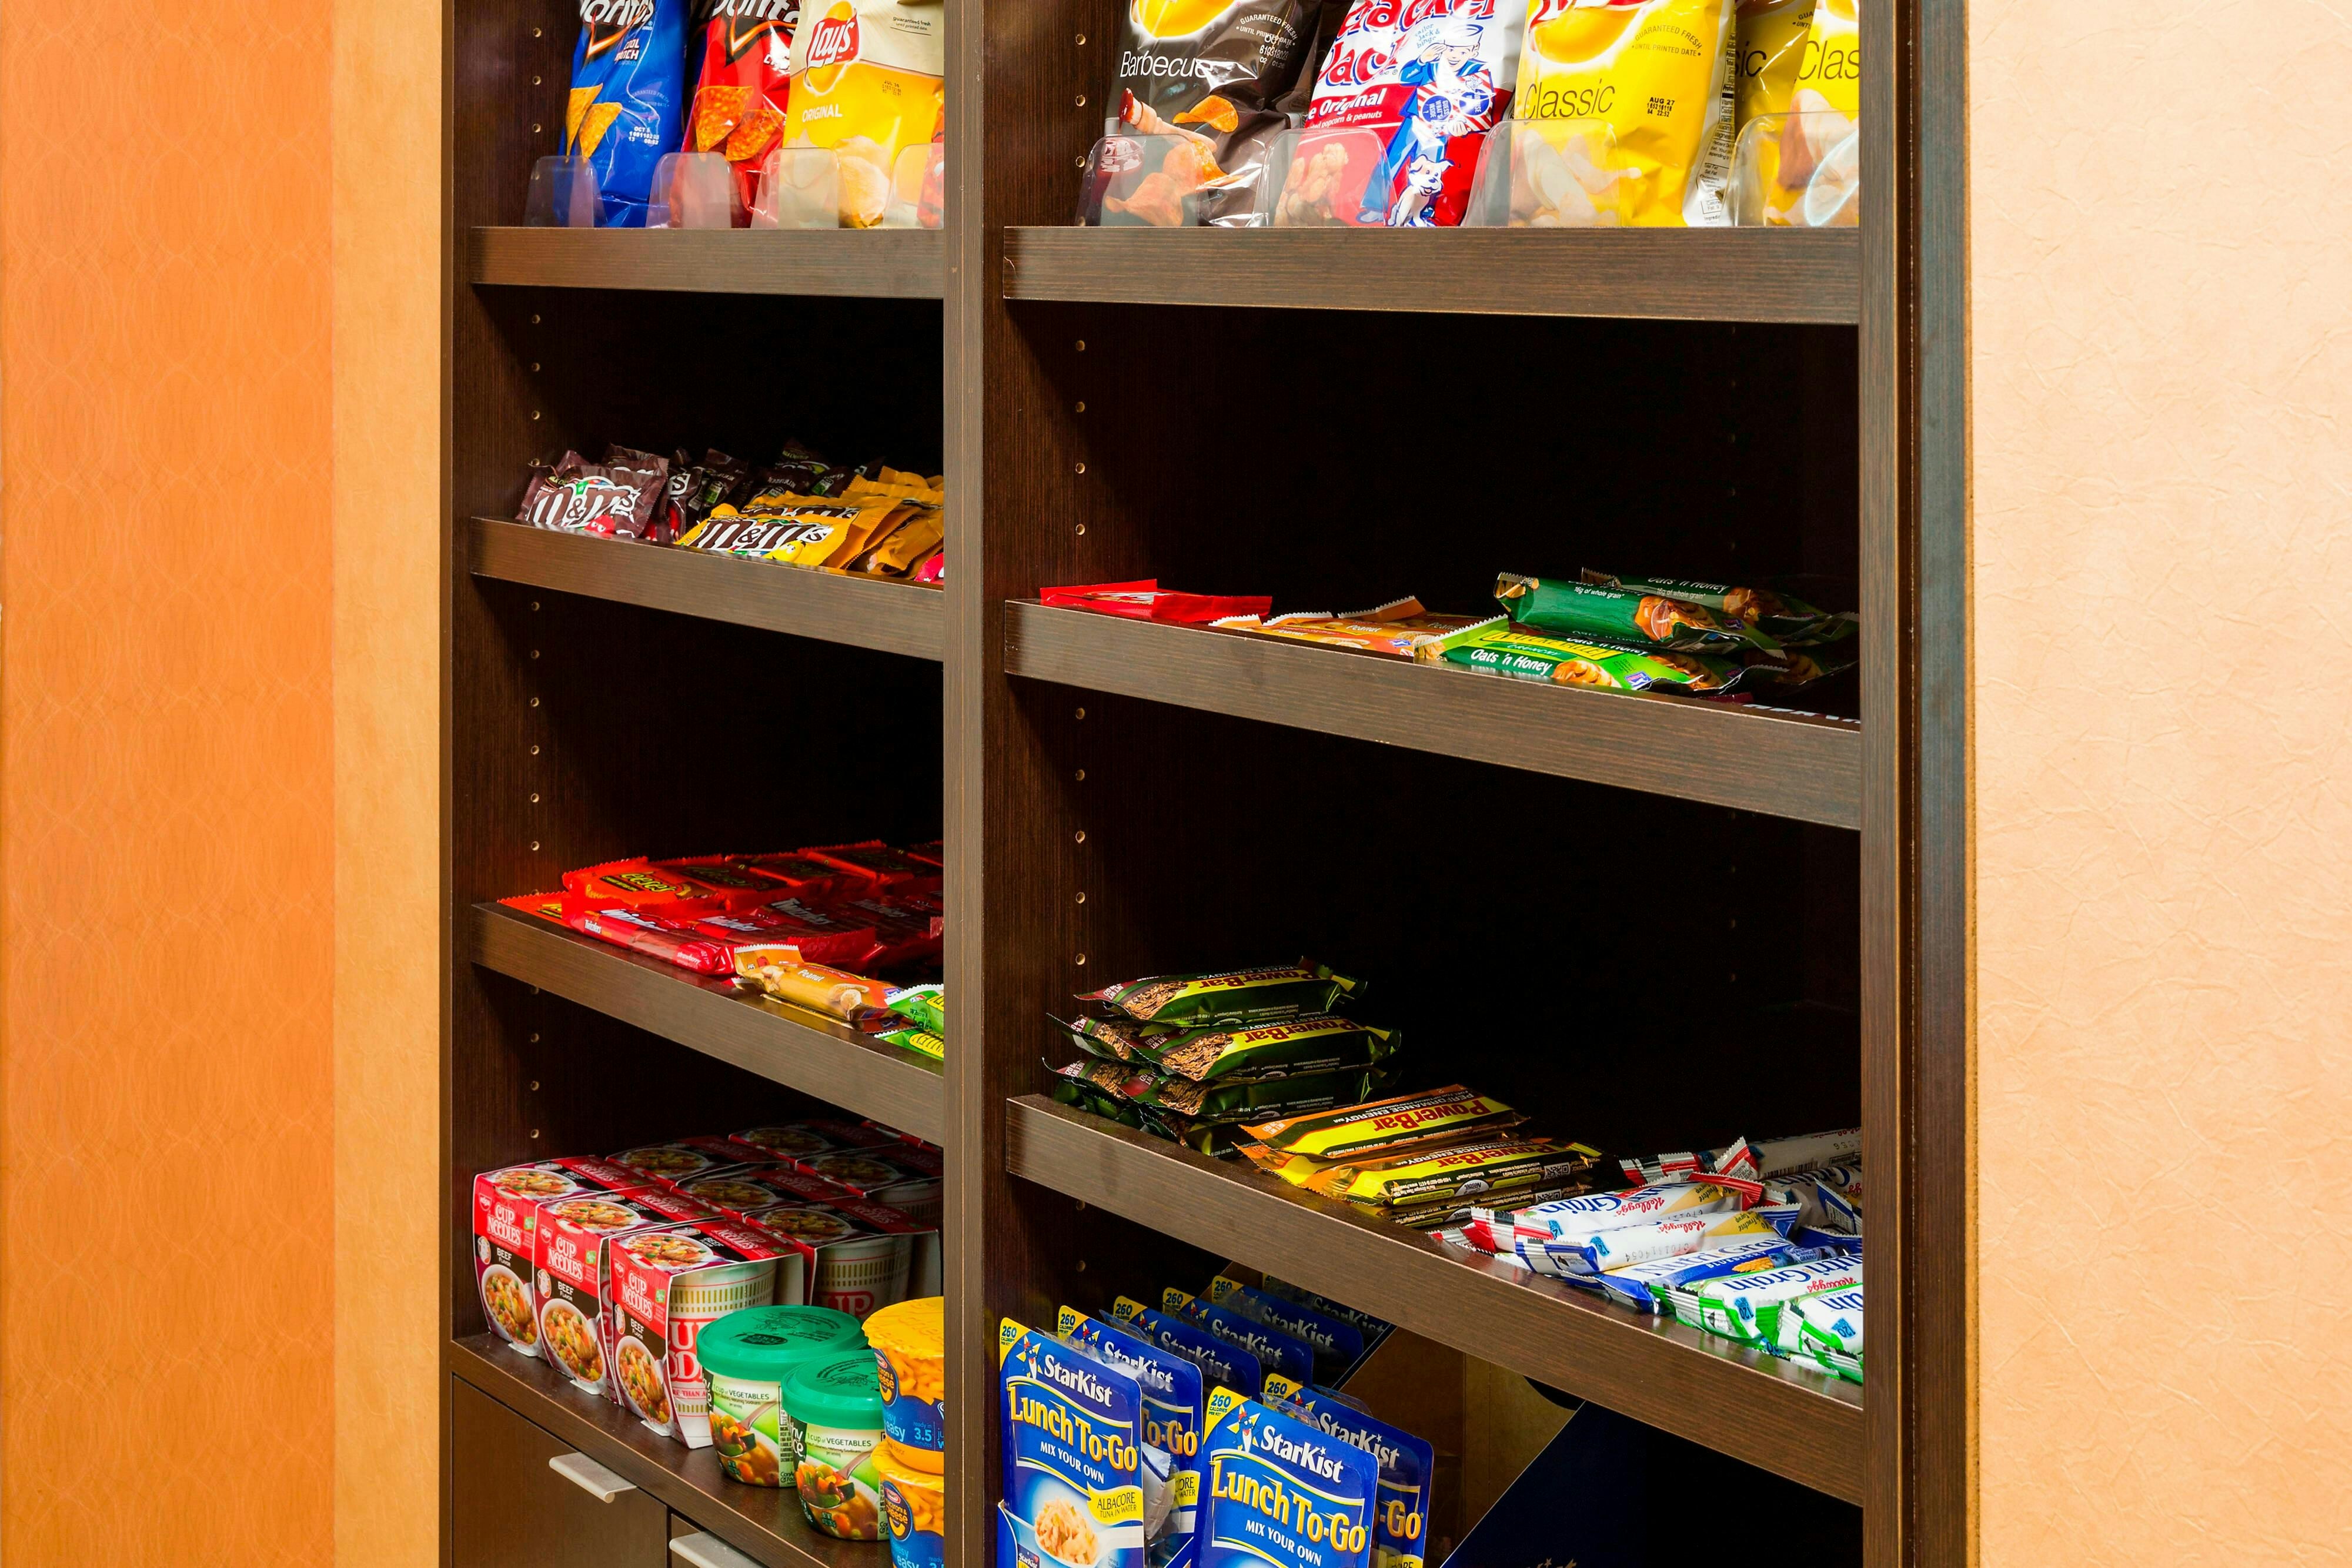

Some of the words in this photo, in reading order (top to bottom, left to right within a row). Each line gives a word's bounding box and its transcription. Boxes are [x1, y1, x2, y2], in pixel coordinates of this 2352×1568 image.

[893, 17, 920, 25] guaranteed
[1240, 14, 1282, 25] GUARANTEED
[1282, 22, 1298, 40] FRESH
[1240, 26, 1255, 35] UNTIL
[807, 18, 855, 68] Lay's
[1635, 25, 1680, 41] GUARANTEED
[1681, 30, 1702, 49] FRESH
[1652, 45, 1679, 54] PRINTED
[1681, 47, 1697, 56] DATE
[1120, 51, 1207, 78] Barbecue
[1798, 41, 1859, 81] Clas
[1319, 88, 1387, 116] Original
[1524, 79, 1615, 119] Classic
[803, 104, 843, 122] ORIGINAL
[1321, 116, 1345, 128] popcorn
[1346, 113, 1352, 122] &
[1353, 111, 1383, 122] peanuts
[1471, 648, 1499, 663] Oats
[1512, 656, 1553, 676] Honey
[677, 951, 701, 964] strawberry
[797, 968, 825, 983] Peanut
[1200, 970, 1321, 989] PowerBar
[1244, 1019, 1360, 1045] PowerBar
[1391, 1093, 1475, 1112] PERFORMANCE
[1345, 1110, 1390, 1123] ENERGY
[1374, 1099, 1491, 1132] PowerBar
[1436, 1146, 1559, 1168] PowerBar
[495, 1202, 515, 1225] CUP
[1543, 1195, 1622, 1216] Grain
[1615, 1197, 1665, 1218] Kellogg's
[487, 1214, 522, 1248] NOODLES
[1658, 1220, 1706, 1234] Kellogg's
[497, 1248, 512, 1261] BEEF
[556, 1235, 577, 1258] CUP
[547, 1247, 583, 1282] NOODLES
[1708, 1251, 1766, 1268] BLUEBERRY
[1812, 1255, 1863, 1276] utri
[558, 1281, 574, 1296] BEEF
[629, 1271, 647, 1297] CUP
[1215, 1280, 1232, 1292] 260
[1722, 1269, 1811, 1292] Grain
[560, 1290, 573, 1301] FLAVOR
[622, 1282, 653, 1322] NOODLES
[1166, 1292, 1184, 1304] 260
[1114, 1303, 1132, 1316] 260
[1739, 1306, 1753, 1320] 120
[630, 1318, 644, 1333] BEEF
[1060, 1313, 1075, 1326] 260
[632, 1328, 644, 1340] FLAVOR
[1001, 1325, 1017, 1339] 260
[1838, 1327, 1856, 1339] 120
[1044, 1354, 1113, 1407] StarKist
[1267, 1382, 1288, 1395] 260
[716, 1385, 725, 1395] cup
[729, 1389, 770, 1400] VEGETABLES
[1211, 1394, 1231, 1408] 260
[886, 1422, 906, 1443] easy
[914, 1427, 933, 1443] 3.5
[1006, 1385, 1074, 1446] Lunch
[1071, 1412, 1138, 1472] To-Go
[810, 1435, 821, 1443] cup
[826, 1438, 871, 1447] VEGETABLES
[1040, 1441, 1056, 1457] MIX
[1058, 1448, 1081, 1473] YOUR
[1083, 1464, 1105, 1485] OWN
[1261, 1425, 1344, 1484] StarKist
[1097, 1491, 1136, 1510] ALBACORE
[1211, 1460, 1290, 1526] Lunch
[1288, 1489, 1366, 1554] To-Go
[1100, 1509, 1114, 1518] TUNA
[1115, 1508, 1121, 1517] IN
[1121, 1504, 1138, 1514] WATER
[1245, 1519, 1265, 1537] MIX
[1268, 1528, 1294, 1554] YOUR
[1297, 1545, 1322, 1567] OWN
